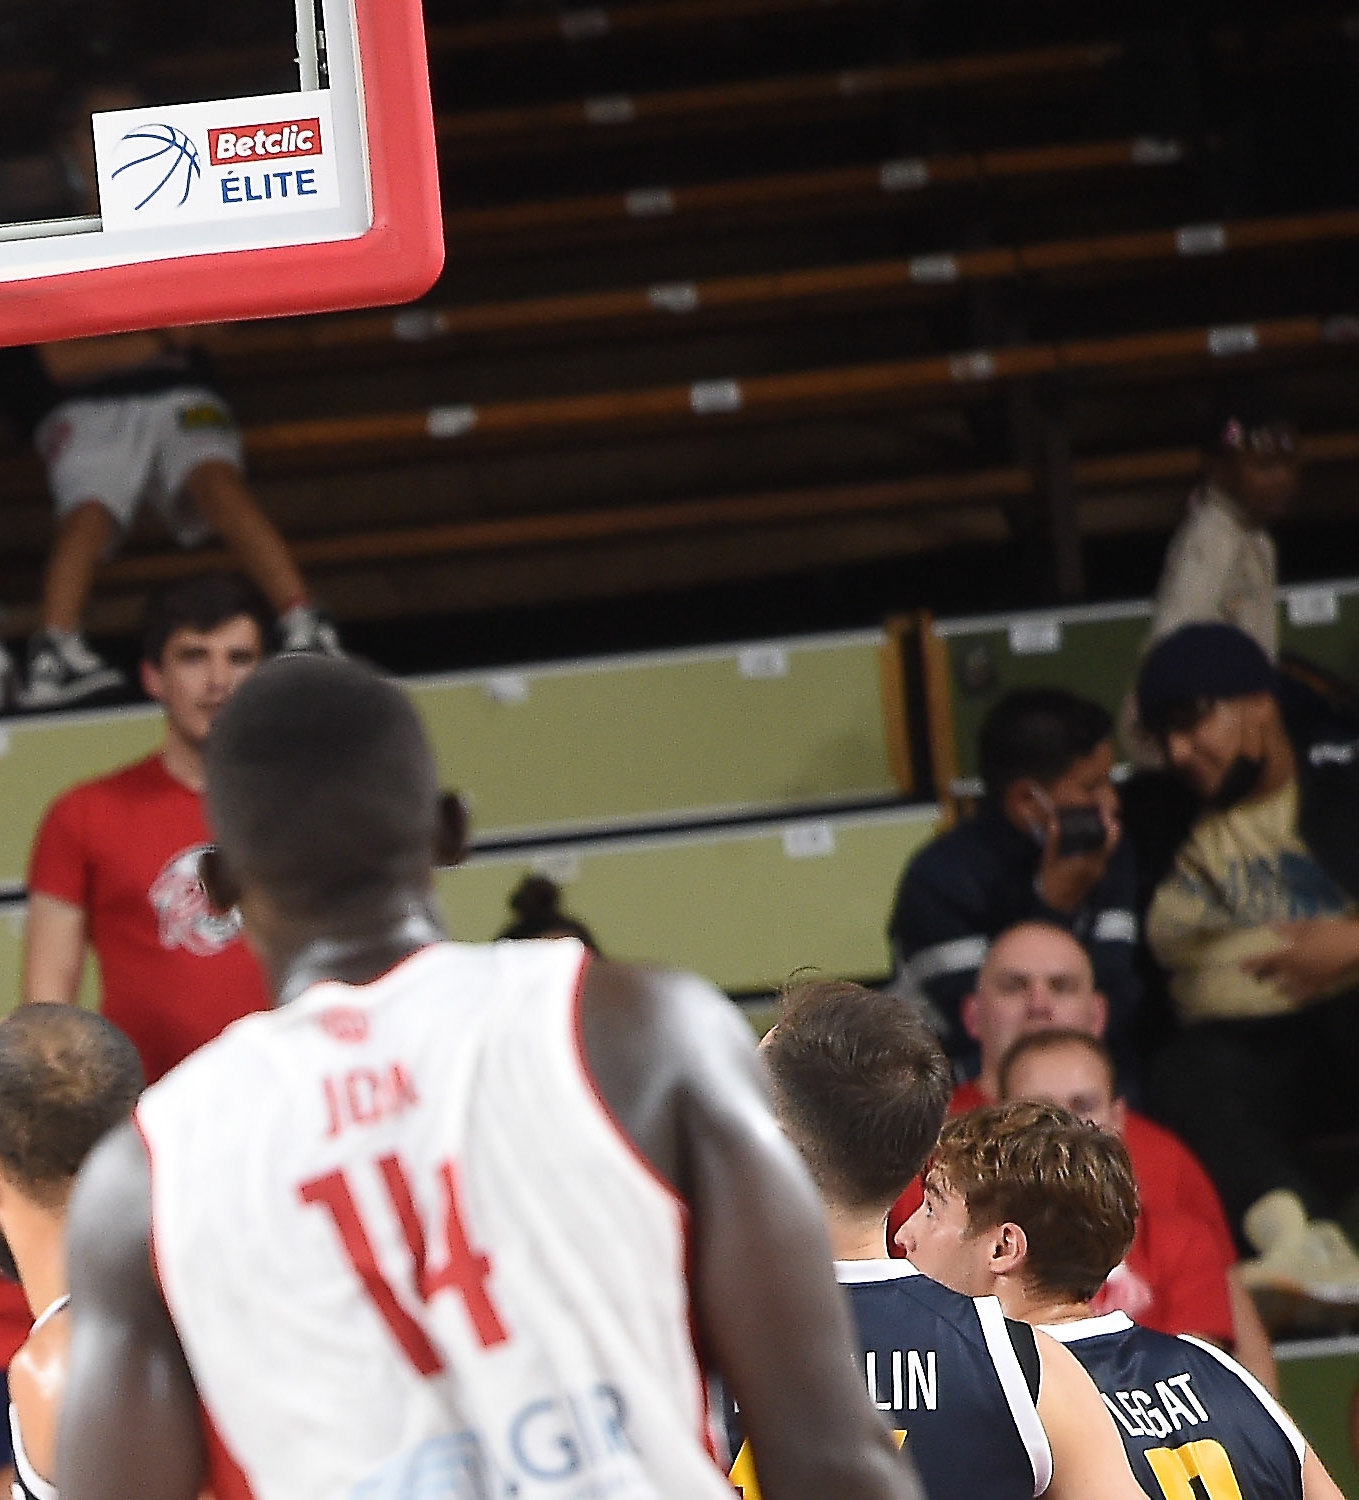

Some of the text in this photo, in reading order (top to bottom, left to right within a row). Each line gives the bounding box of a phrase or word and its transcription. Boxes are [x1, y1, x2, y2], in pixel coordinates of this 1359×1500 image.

[216, 124, 314, 159] Betclic
[220, 169, 318, 204] ÉLITE
[298, 1153, 508, 1375] 14
